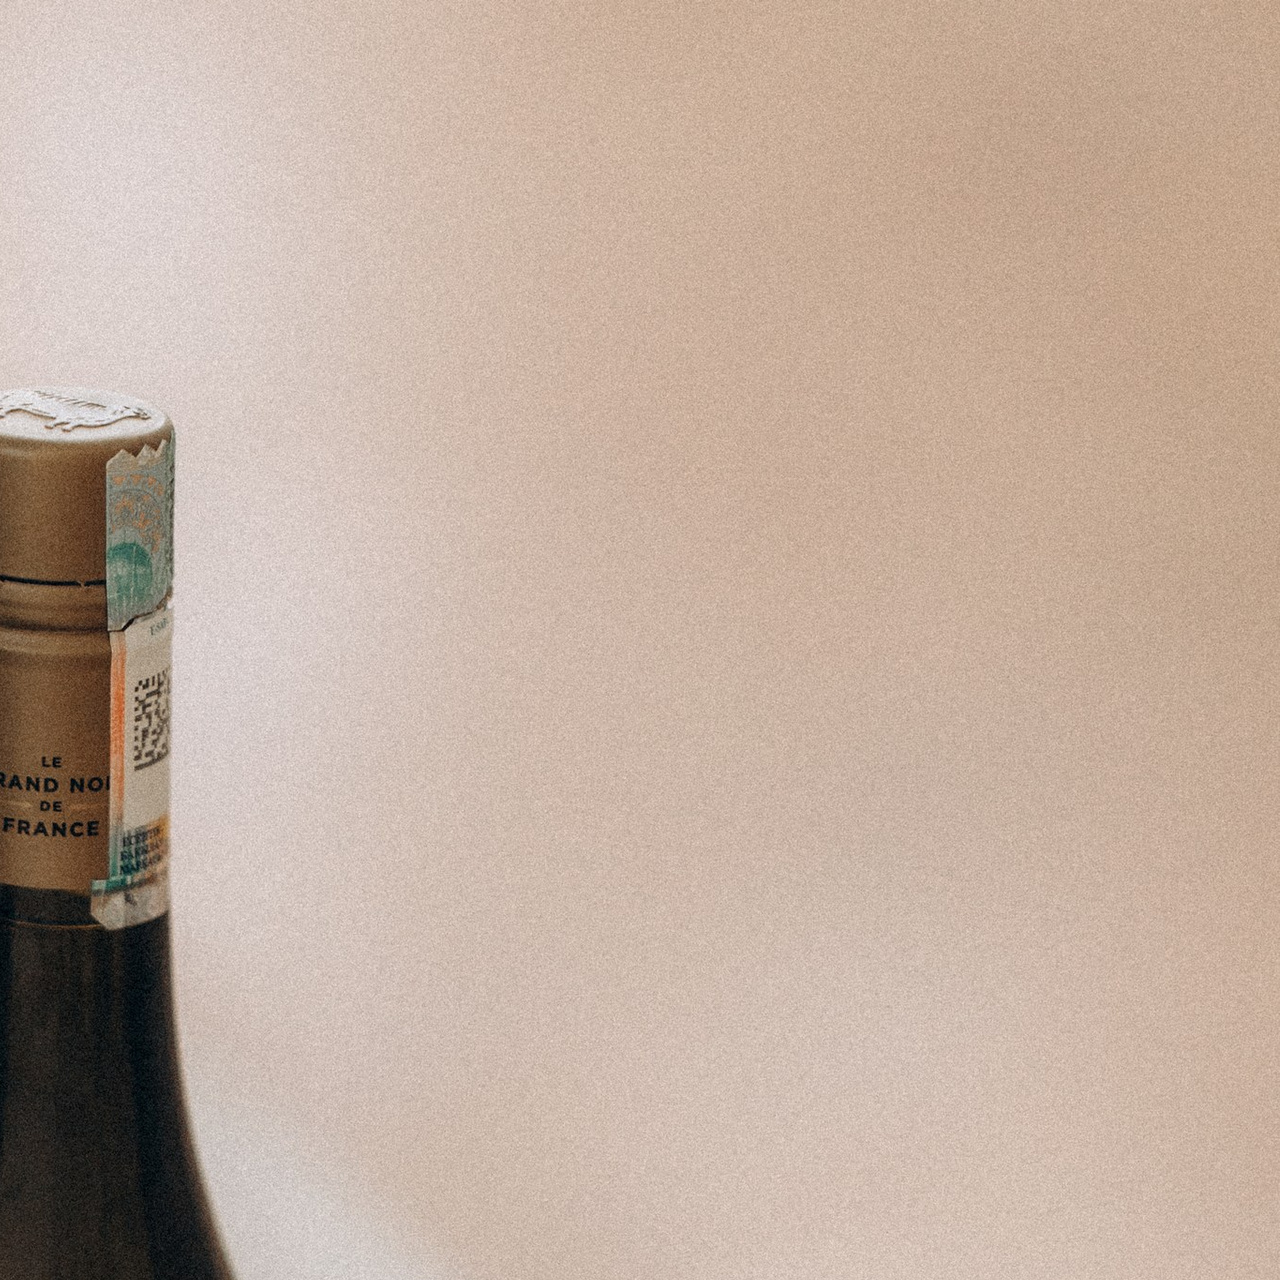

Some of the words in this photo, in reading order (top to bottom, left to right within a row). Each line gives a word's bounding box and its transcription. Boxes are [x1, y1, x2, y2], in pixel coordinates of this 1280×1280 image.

[41, 756, 63, 768] LE
[70, 776, 111, 793] NOI
[39, 800, 63, 813] DE
[2, 816, 100, 837] FRANCE
